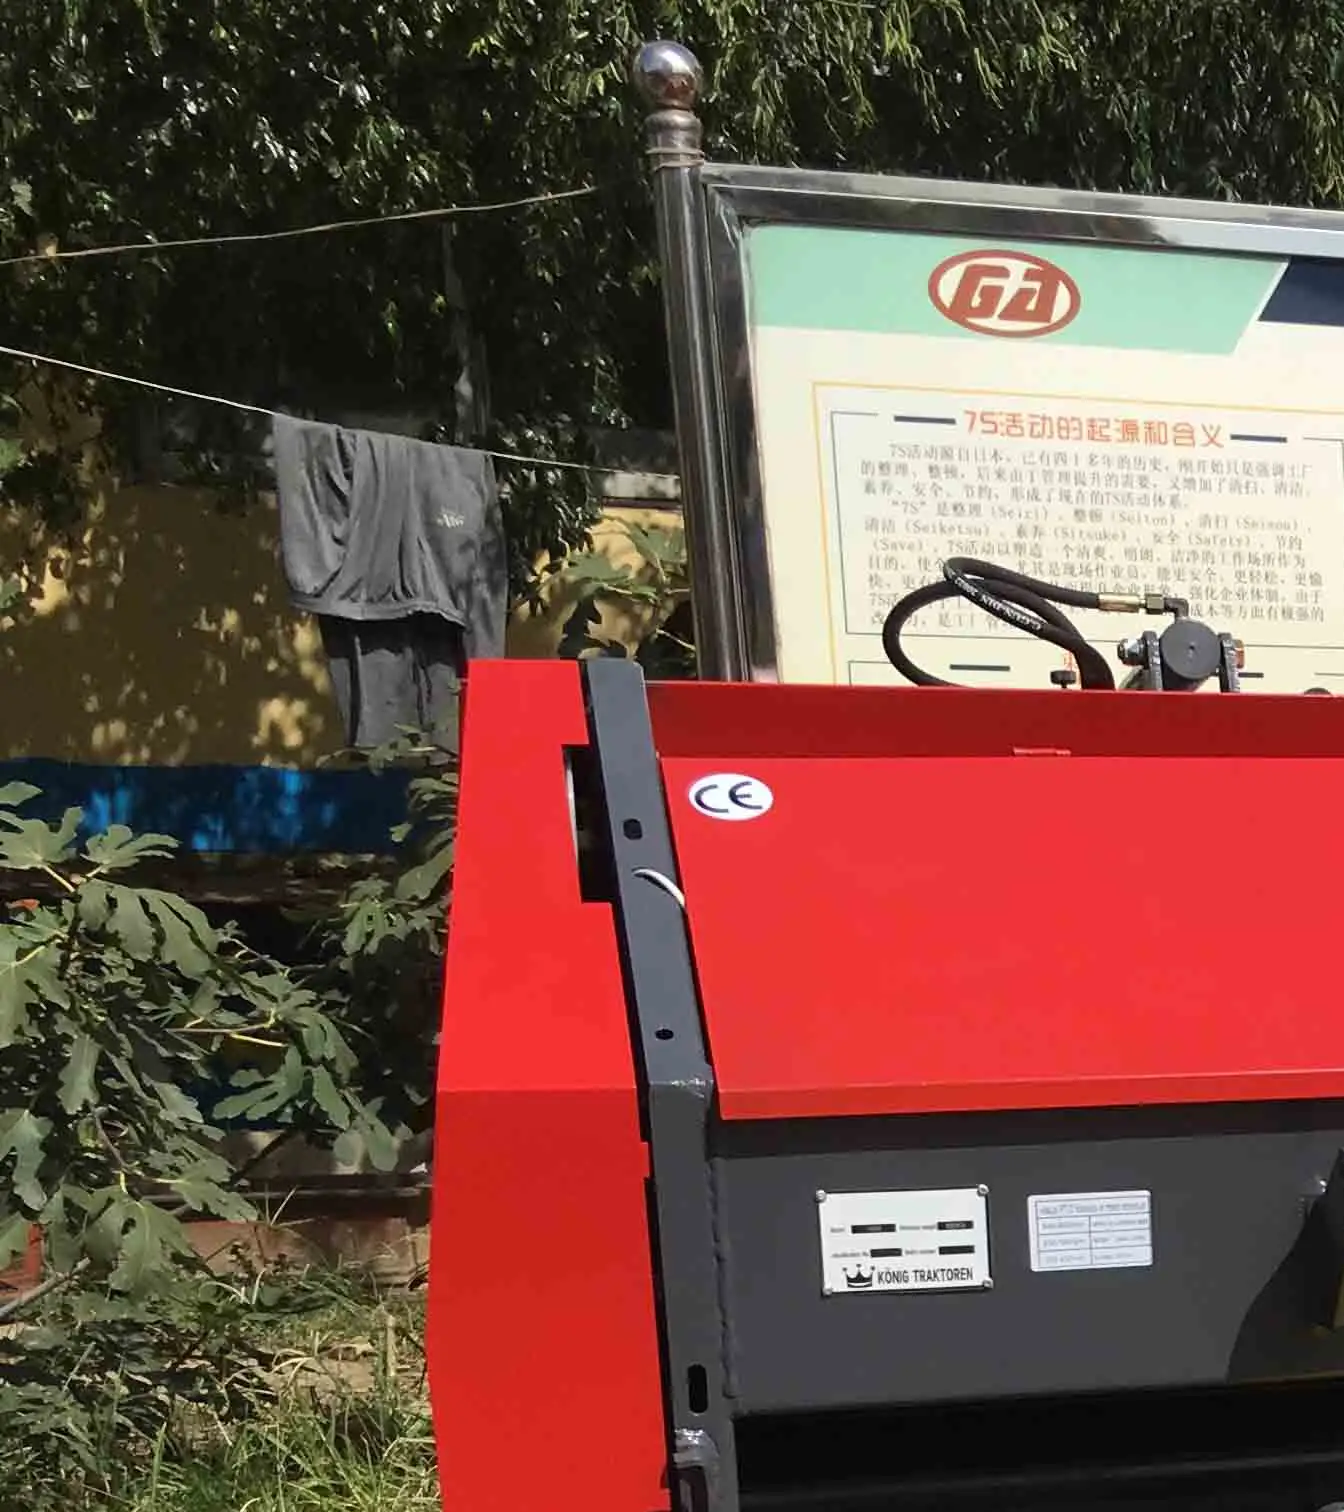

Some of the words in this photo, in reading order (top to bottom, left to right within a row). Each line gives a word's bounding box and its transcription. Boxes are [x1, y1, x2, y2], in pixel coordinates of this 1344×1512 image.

[963, 409, 1224, 448] 7S活动的起源和含义
[695, 780, 763, 813] CE
[912, 1266, 974, 1282] TRAKTOREN
